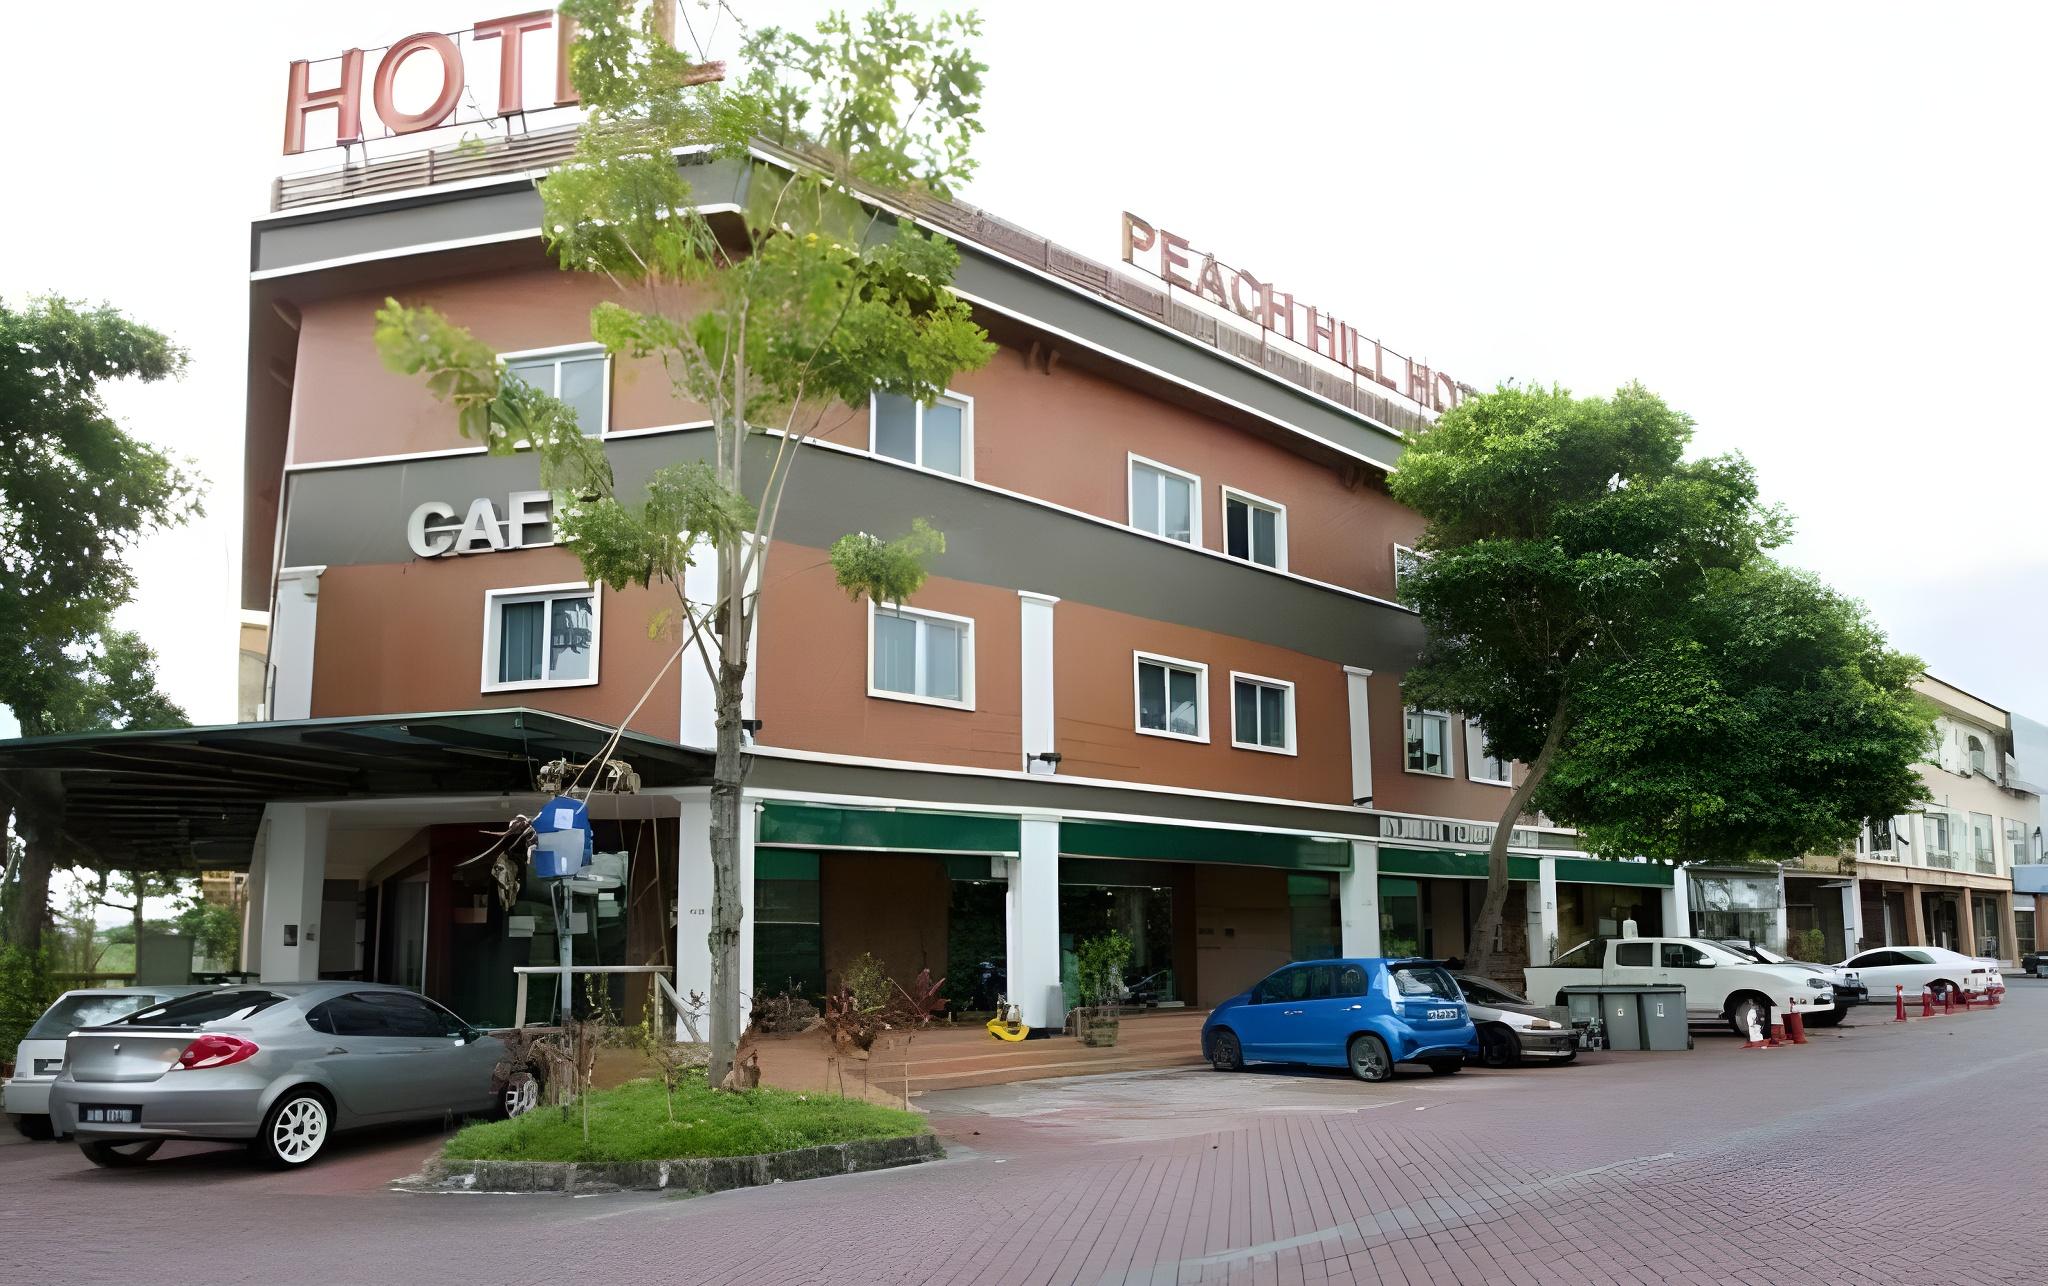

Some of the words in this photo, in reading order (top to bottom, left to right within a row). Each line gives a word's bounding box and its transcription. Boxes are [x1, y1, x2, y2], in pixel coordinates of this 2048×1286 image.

[1122, 210, 1294, 341] PEACH
[1307, 306, 1397, 391] HILL
[408, 490, 581, 557] CAF
